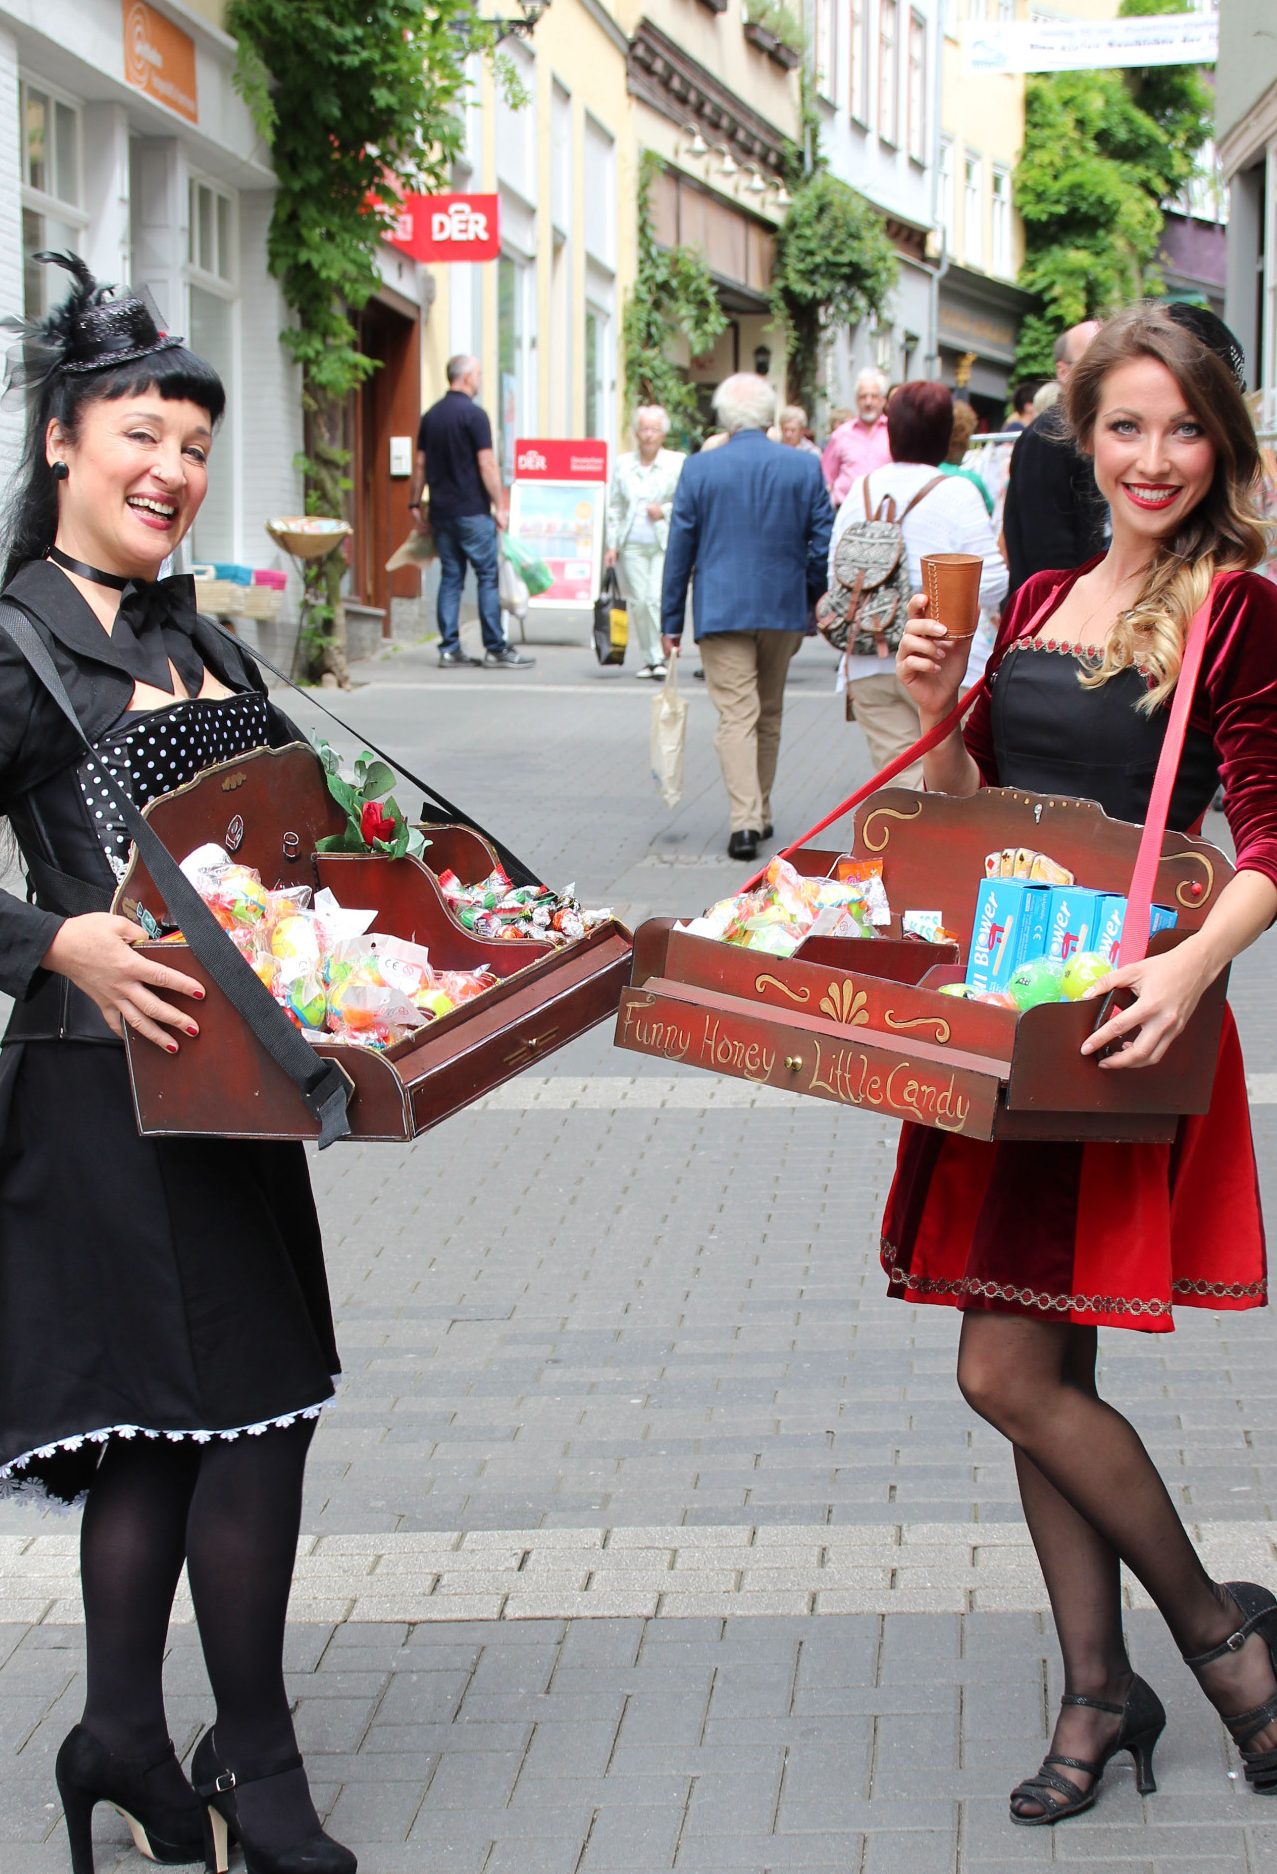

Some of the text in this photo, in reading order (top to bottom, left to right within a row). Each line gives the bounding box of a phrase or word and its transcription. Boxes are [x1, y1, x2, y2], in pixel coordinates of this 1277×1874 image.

[431, 209, 490, 241] DER
[974, 891, 998, 967] Blower
[624, 994, 691, 1060] Funny
[700, 1015, 776, 1084] Honey
